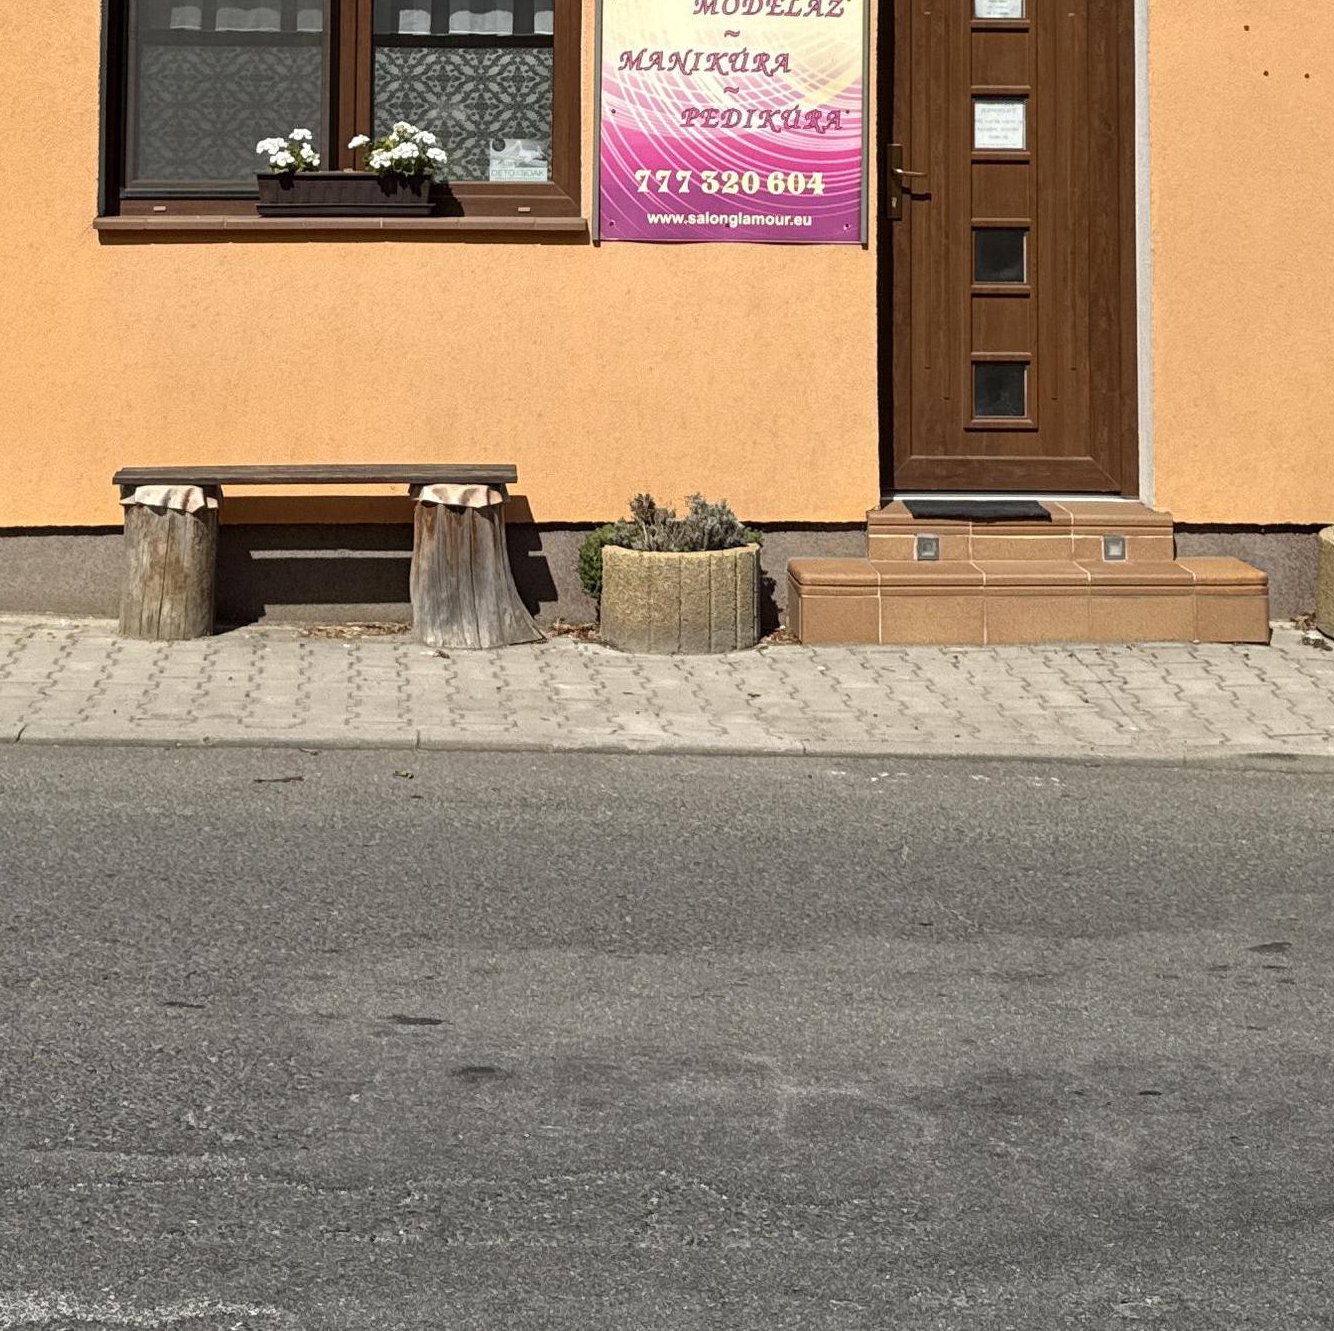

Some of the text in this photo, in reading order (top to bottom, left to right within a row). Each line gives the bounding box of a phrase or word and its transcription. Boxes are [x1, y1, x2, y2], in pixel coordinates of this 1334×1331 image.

[617, 47, 792, 77] MANIKÚRA
[680, 105, 844, 134] PEDIKÚRA
[634, 169, 826, 196] 777 320 604
[647, 211, 812, 228] www.salonglamour.eu
